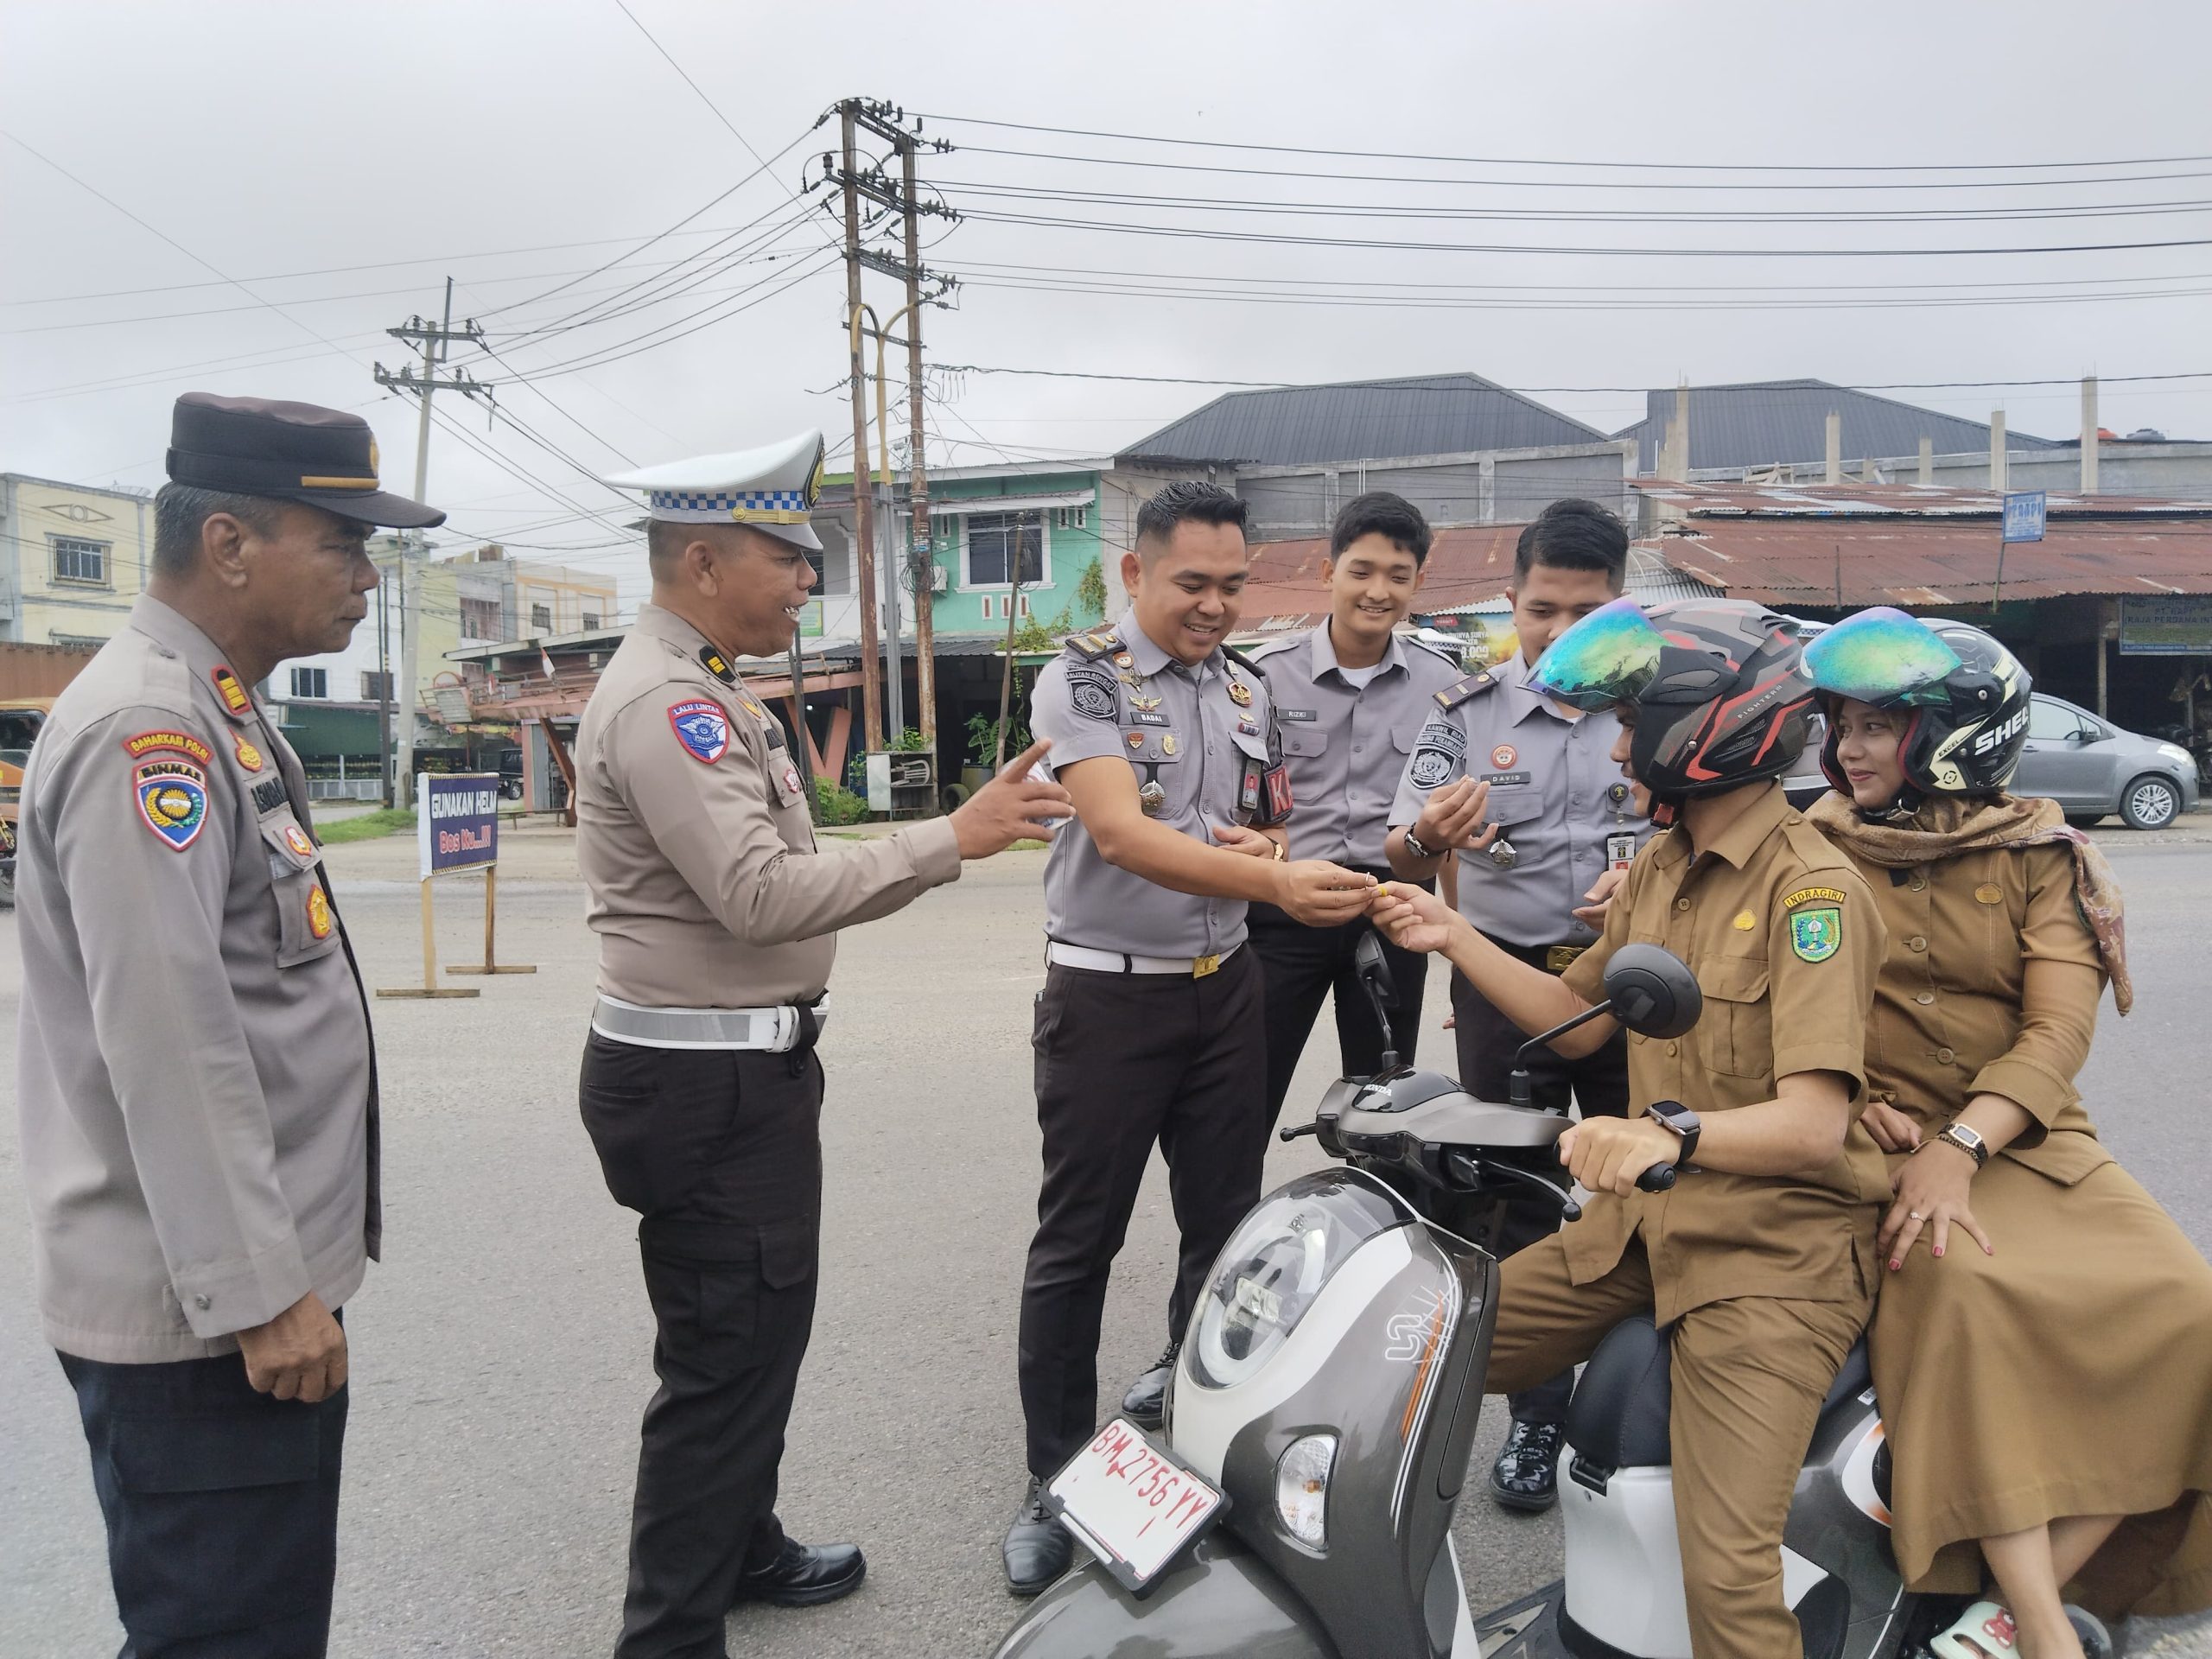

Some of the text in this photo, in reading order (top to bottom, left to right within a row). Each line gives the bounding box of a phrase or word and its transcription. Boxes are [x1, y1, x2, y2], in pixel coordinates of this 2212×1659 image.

[673, 702, 721, 715] LALU LINTAS
[1737, 690, 1777, 719] FIGHTER
[1141, 714, 1163, 722] BADAI
[1427, 724, 1466, 743] KANWIL RIAU
[130, 734, 209, 760] BAHARKAM POLRI
[1938, 739, 1961, 758] EXCEL
[142, 763, 201, 781] BINMAS
[1492, 774, 1521, 783] DAVID
[432, 790, 498, 819] GUNAKAN HELM
[440, 830, 461, 854] Bos
[1787, 889, 1843, 906] INDRAGIRI
[1363, 1084, 1392, 1096] HONDA
[1092, 1424, 1134, 1464] BM
[1116, 1448, 1179, 1507] 2756
[1166, 1486, 1209, 1529] YY
